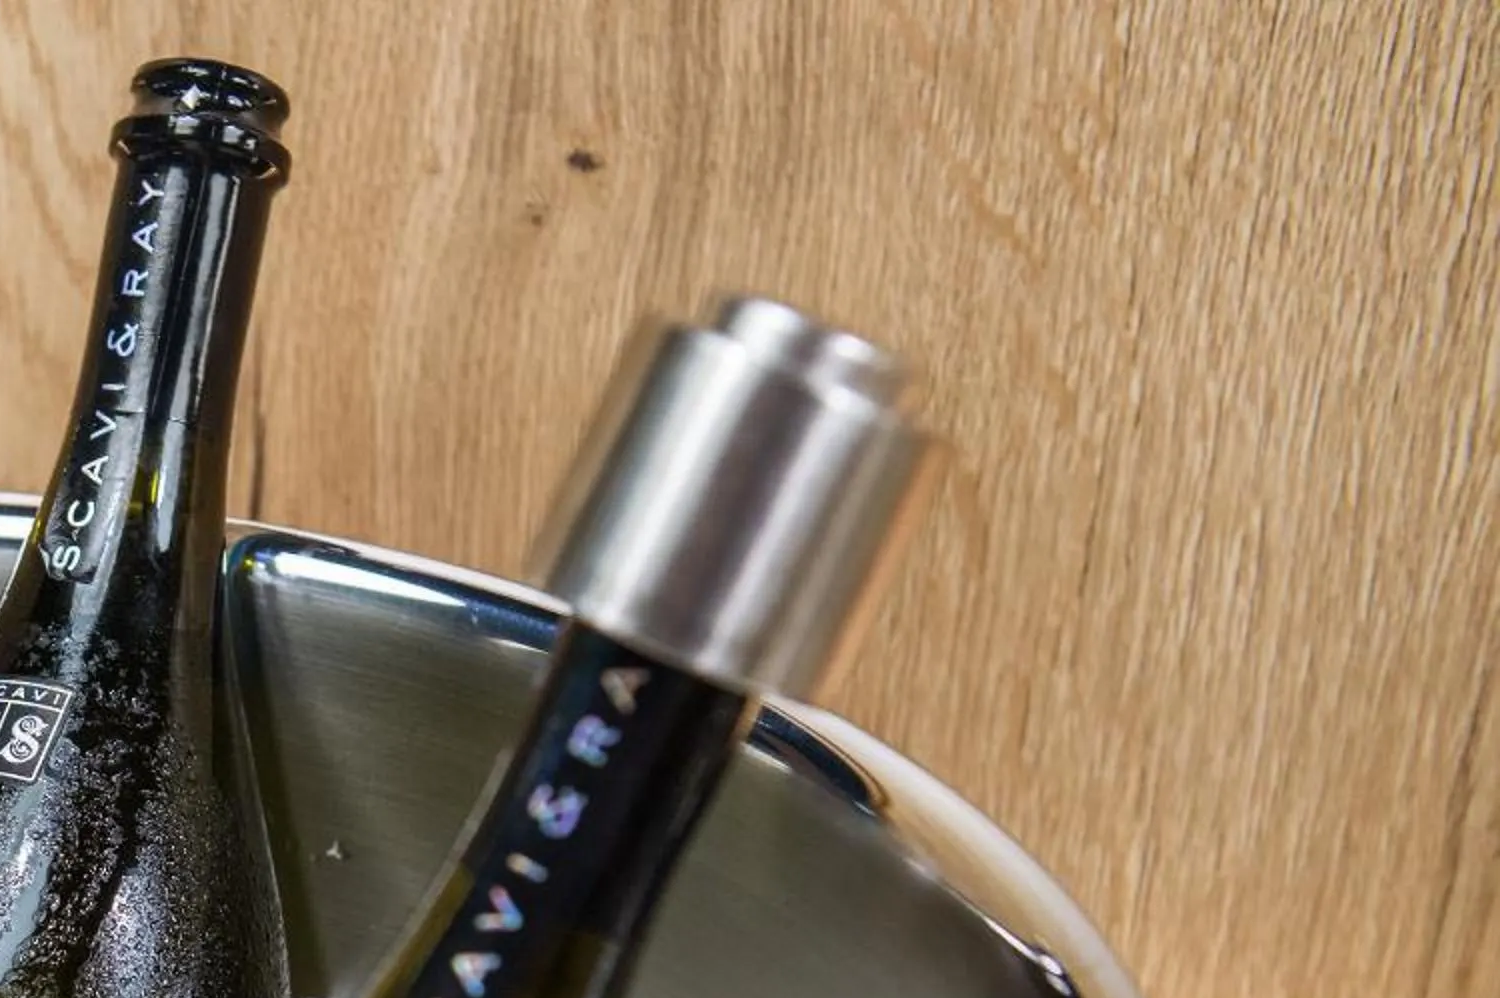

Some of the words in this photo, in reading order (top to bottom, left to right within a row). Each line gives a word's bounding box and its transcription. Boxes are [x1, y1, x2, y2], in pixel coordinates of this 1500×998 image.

[52, 382, 127, 571] SCAVI
[107, 322, 139, 356] &
[123, 178, 164, 297] RAY
[566, 666, 651, 767] RA
